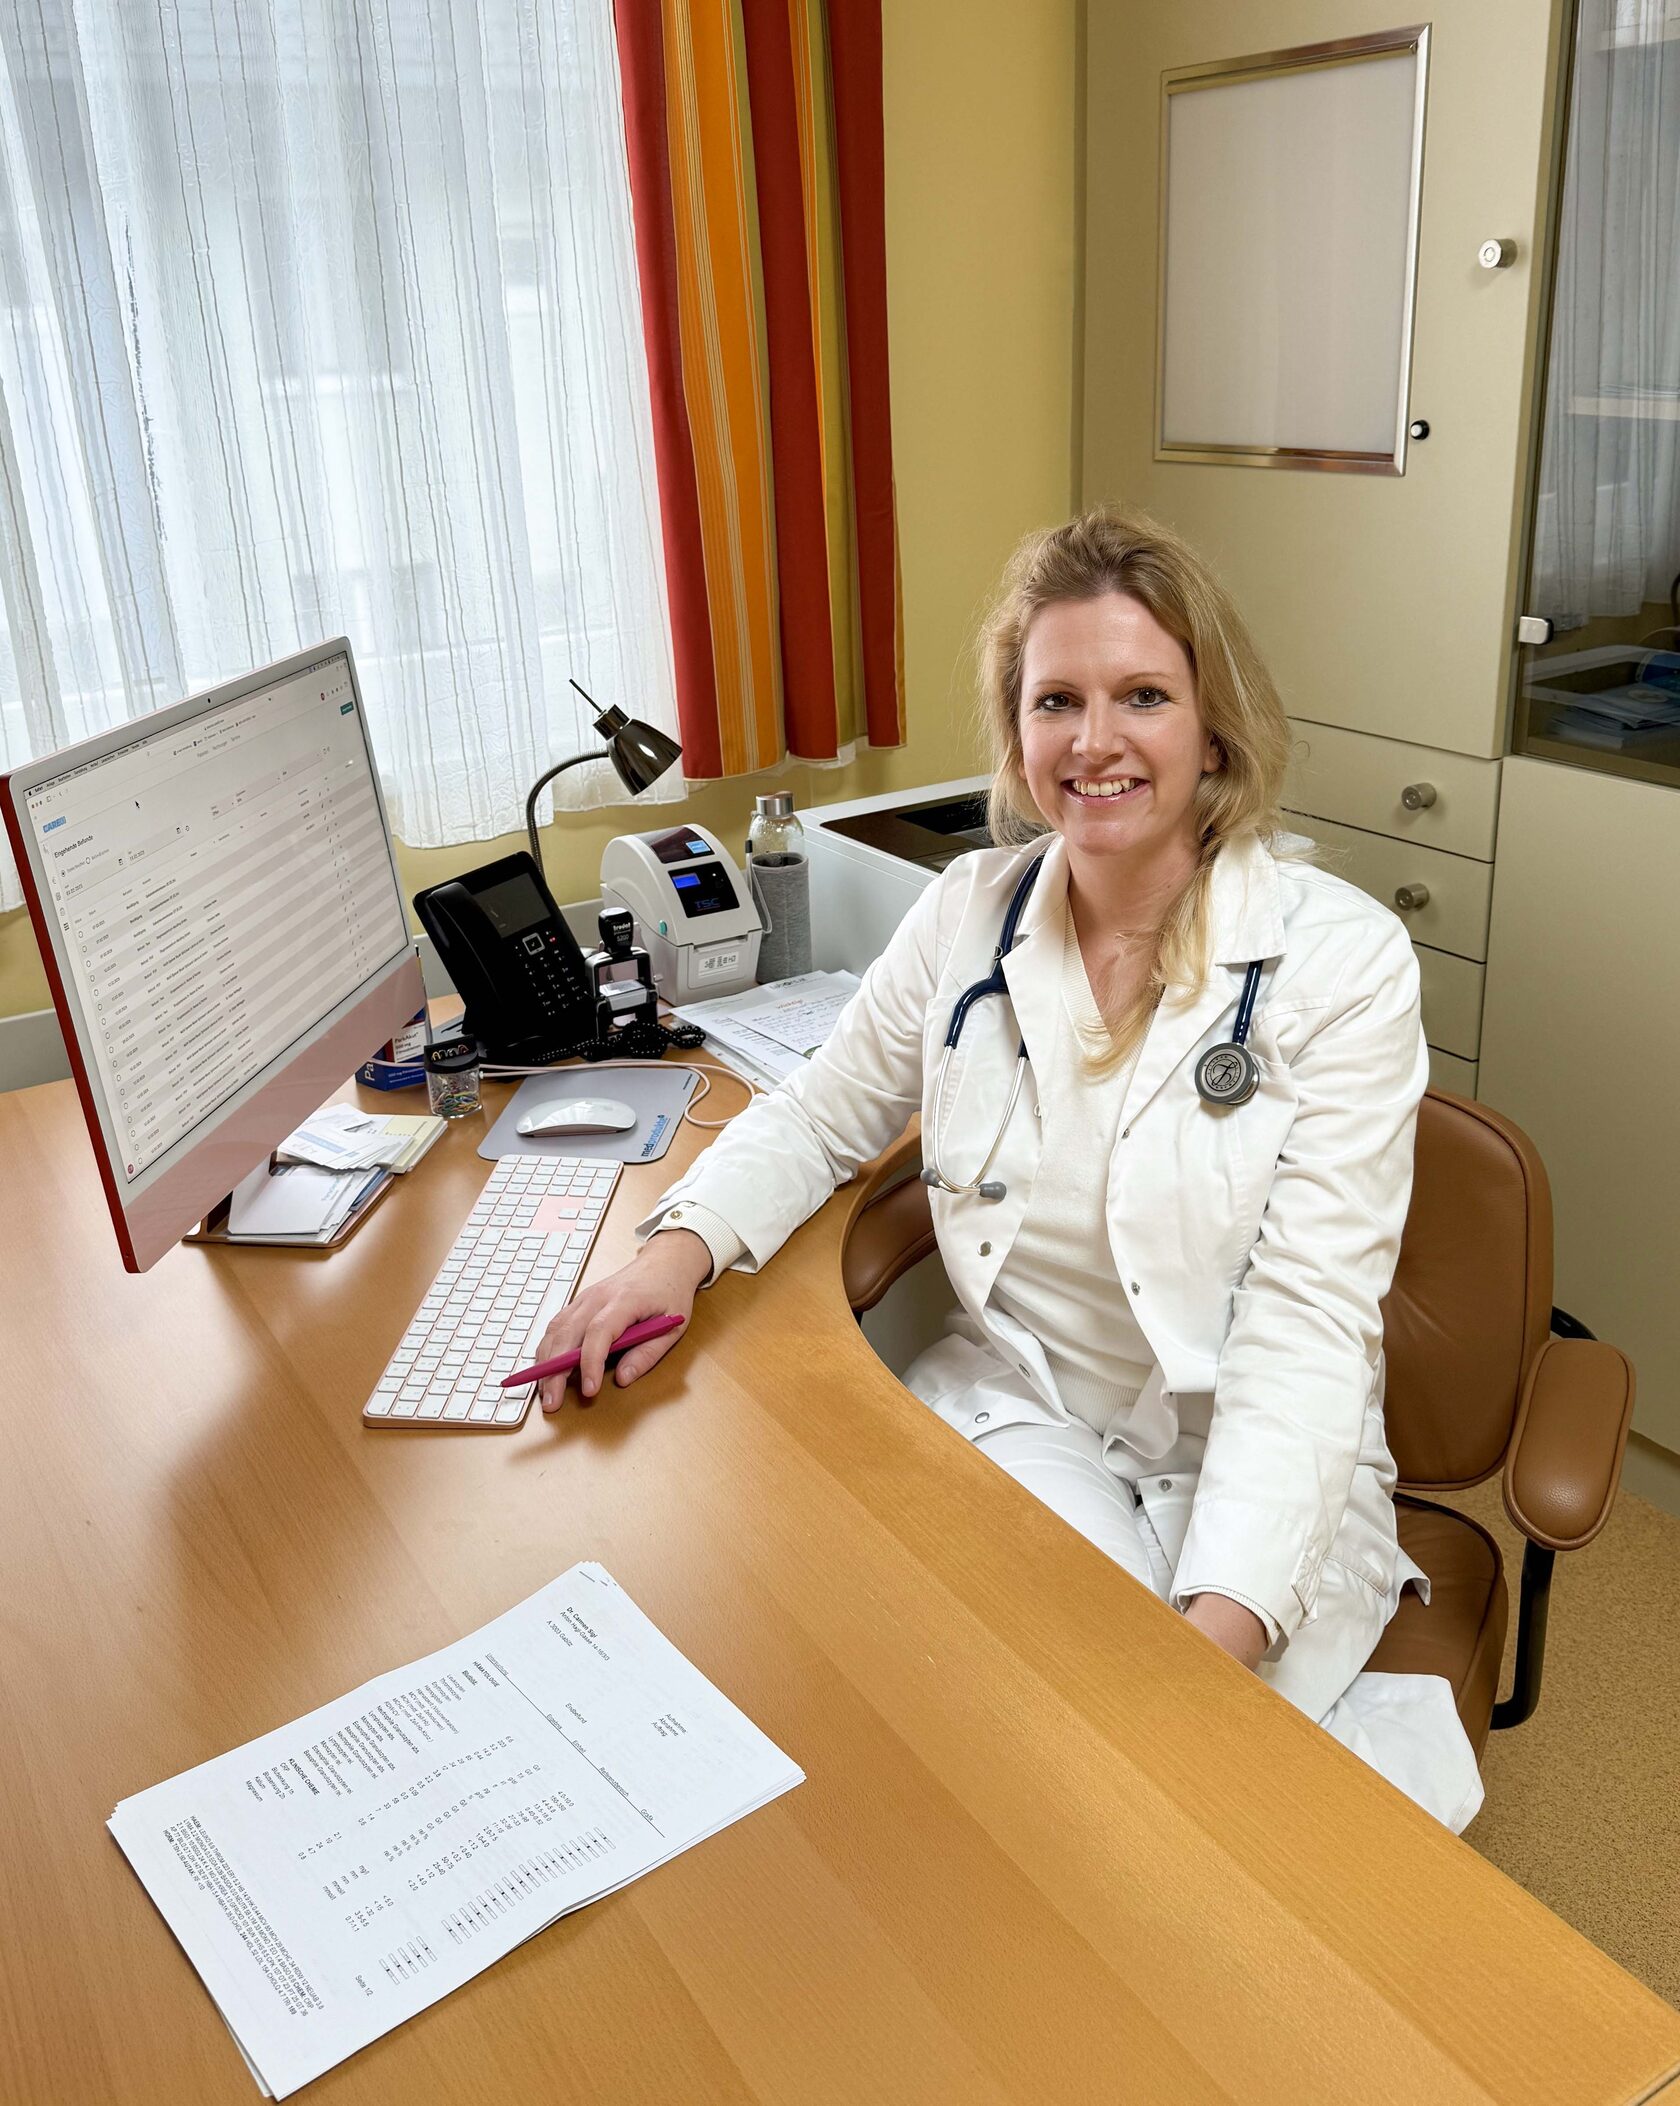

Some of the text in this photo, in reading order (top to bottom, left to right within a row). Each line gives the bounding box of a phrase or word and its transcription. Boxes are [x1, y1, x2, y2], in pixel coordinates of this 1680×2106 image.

[54, 841, 77, 859] Eingehende
[77, 833, 93, 847] Befunde
[694, 896, 721, 910] TSC
[559, 1610, 574, 1624] Anton
[571, 1613, 590, 1630] Carmen
[549, 1623, 562, 1634] 3003
[565, 1702, 588, 1724] Endbefund
[571, 1739, 586, 1754] Einheit
[287, 1757, 320, 1795] KLINISCHE CHEMIE
[354, 1974, 373, 1996] Seite 1/2
